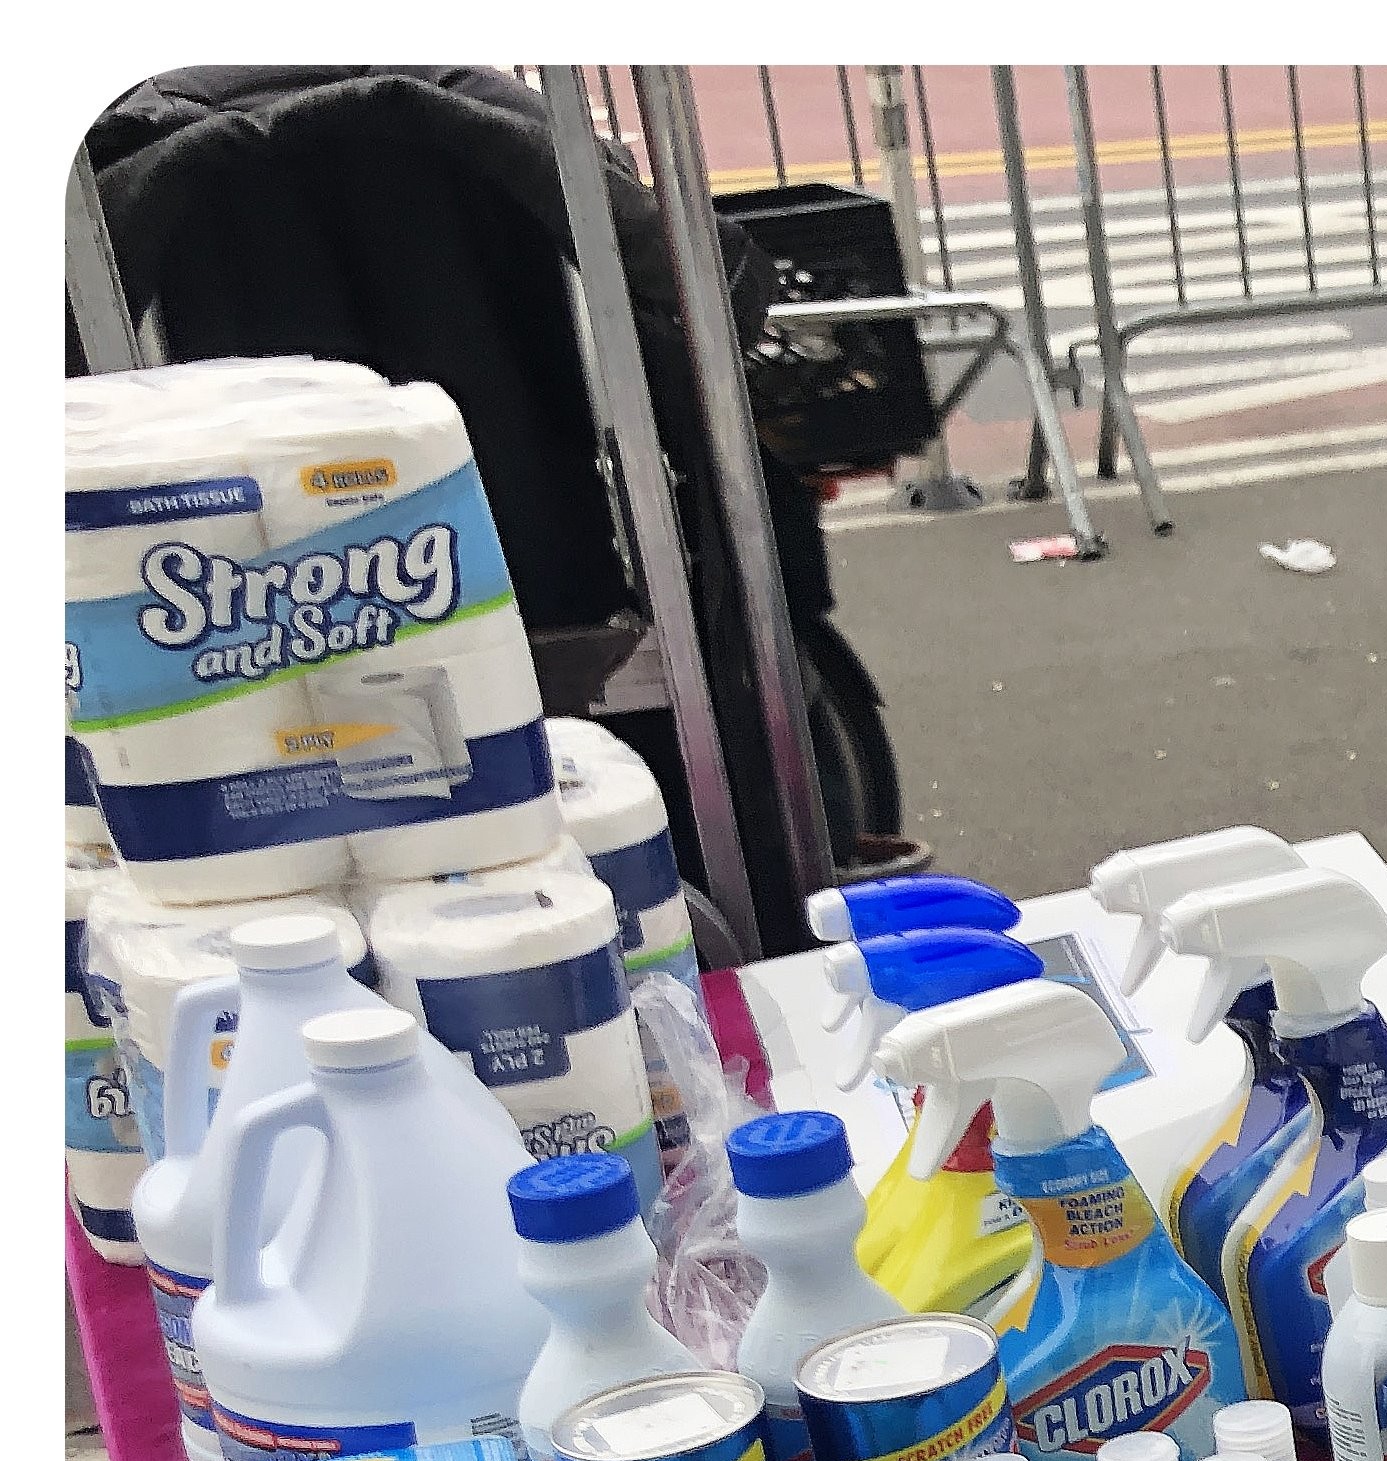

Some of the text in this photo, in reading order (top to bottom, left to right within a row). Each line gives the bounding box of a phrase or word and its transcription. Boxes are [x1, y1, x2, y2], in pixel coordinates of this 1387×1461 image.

[139, 522, 458, 651] Strong
[193, 602, 401, 681] and Soft
[1059, 1186, 1125, 1208] FOAMING
[1066, 1202, 1124, 1221] BLEACH
[1069, 1217, 1124, 1237] ACTION
[1034, 1340, 1193, 1452] CLOROX
[966, 1402, 994, 1434] FREE
